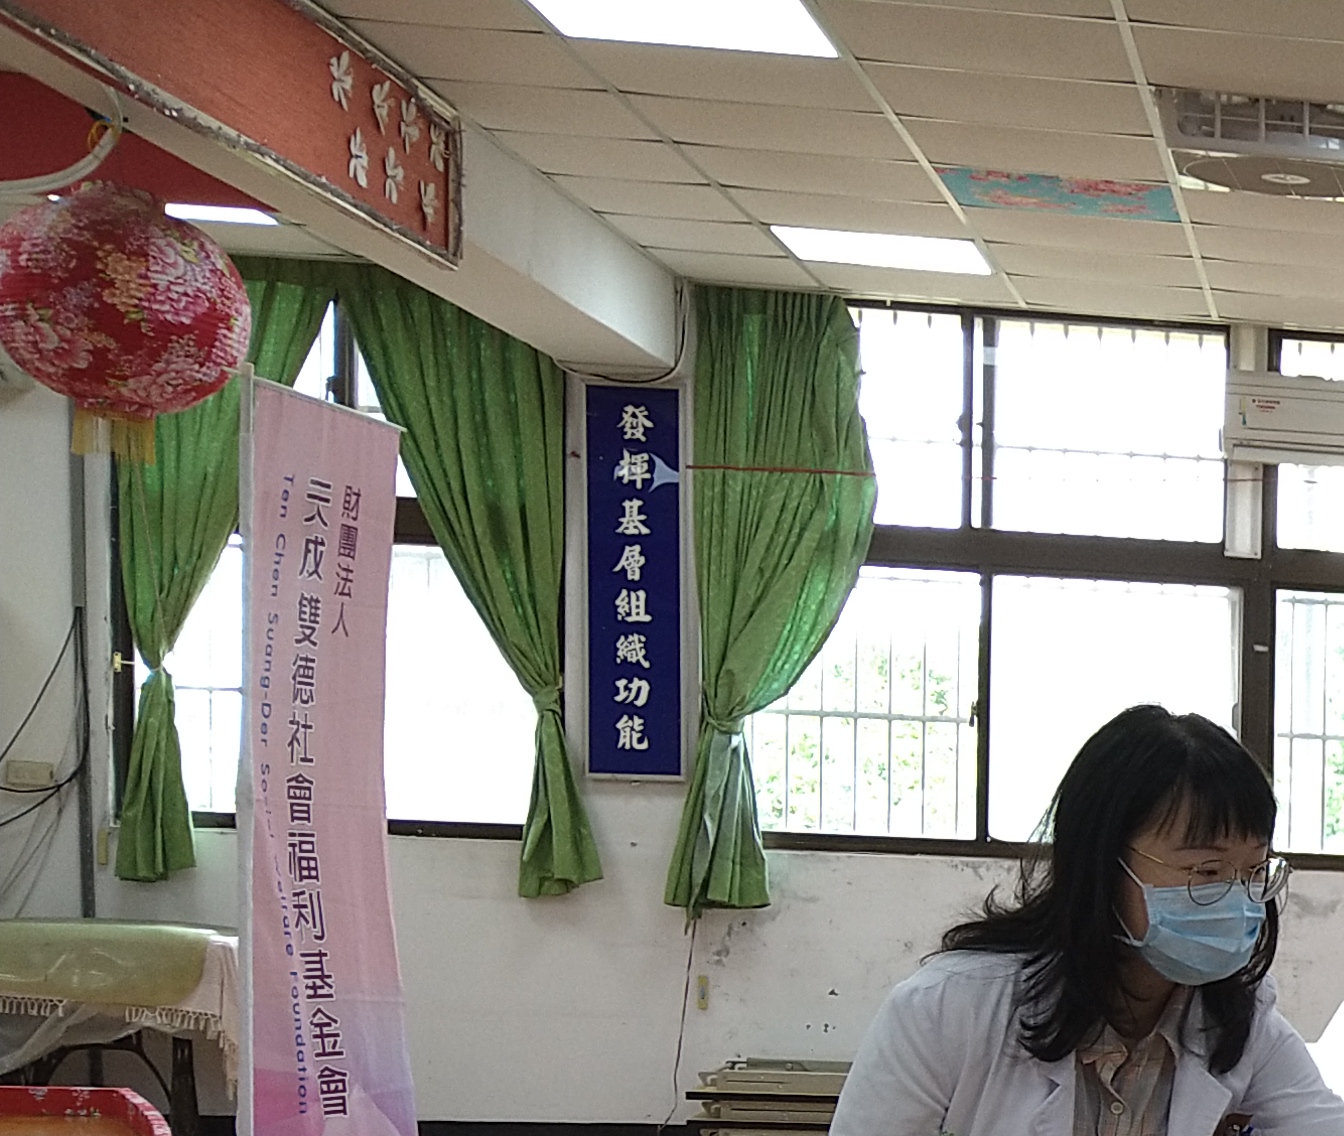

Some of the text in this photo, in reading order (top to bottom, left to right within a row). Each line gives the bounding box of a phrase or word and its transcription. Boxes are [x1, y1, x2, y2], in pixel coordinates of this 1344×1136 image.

[279, 474, 296, 518] Ten
[330, 485, 361, 638] 財團法人
[270, 533, 287, 598] Chen
[612, 404, 655, 752] 發揮基層組織功能
[259, 612, 280, 747] Suang-Der
